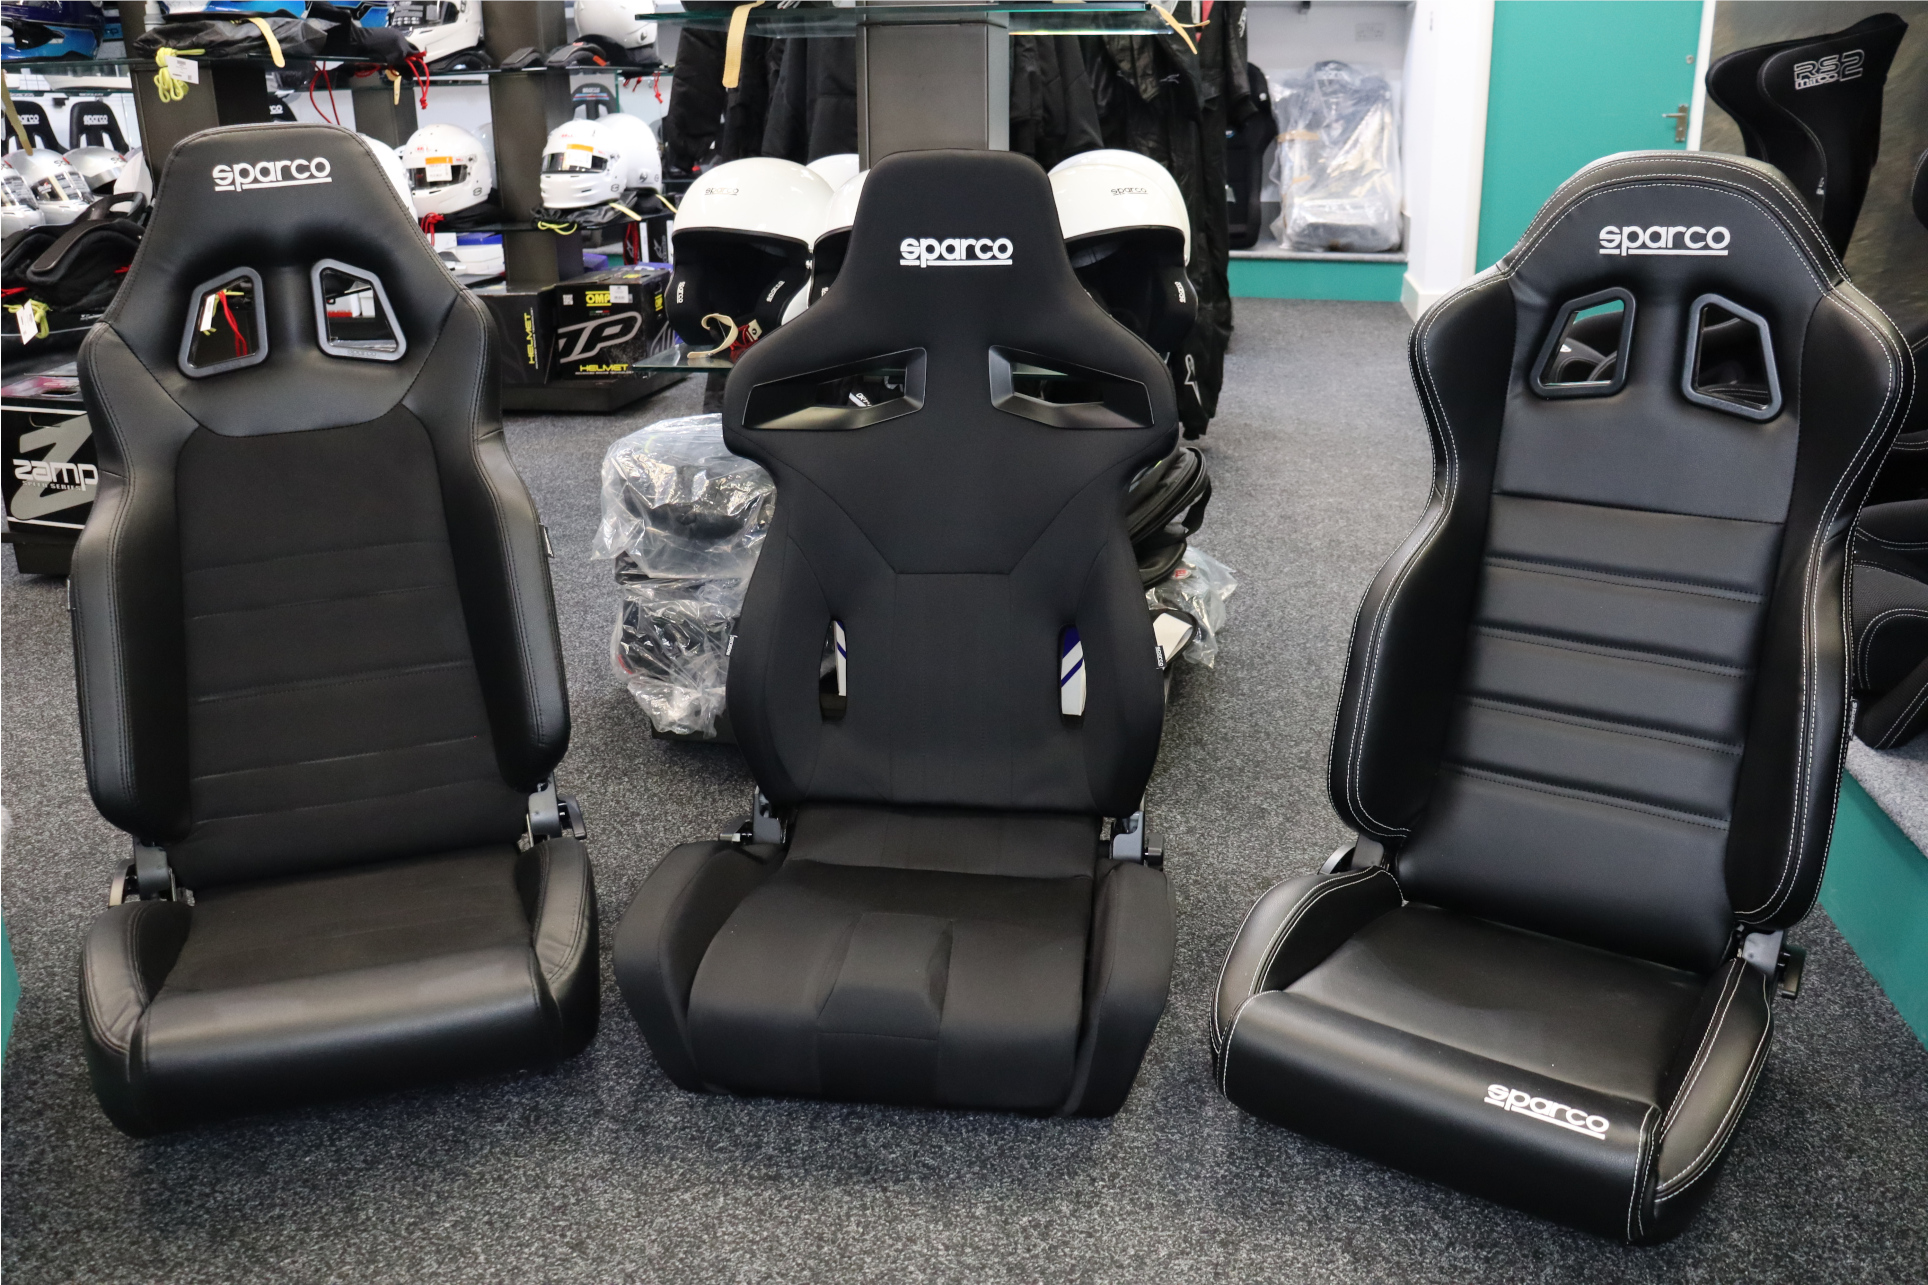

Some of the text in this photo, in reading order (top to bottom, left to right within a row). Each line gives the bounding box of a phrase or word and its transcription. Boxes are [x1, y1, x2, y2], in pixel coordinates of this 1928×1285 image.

[212, 157, 332, 192] sparco
[705, 187, 740, 196] sparco
[1110, 187, 1149, 196] sparco
[900, 238, 1014, 268] sparco
[1599, 225, 1731, 256] sparco
[585, 291, 613, 307] OMP
[523, 312, 535, 365] HELMET
[579, 363, 629, 372] HELMET
[12, 458, 99, 491] zamp
[1483, 1083, 1610, 1140] sparco
